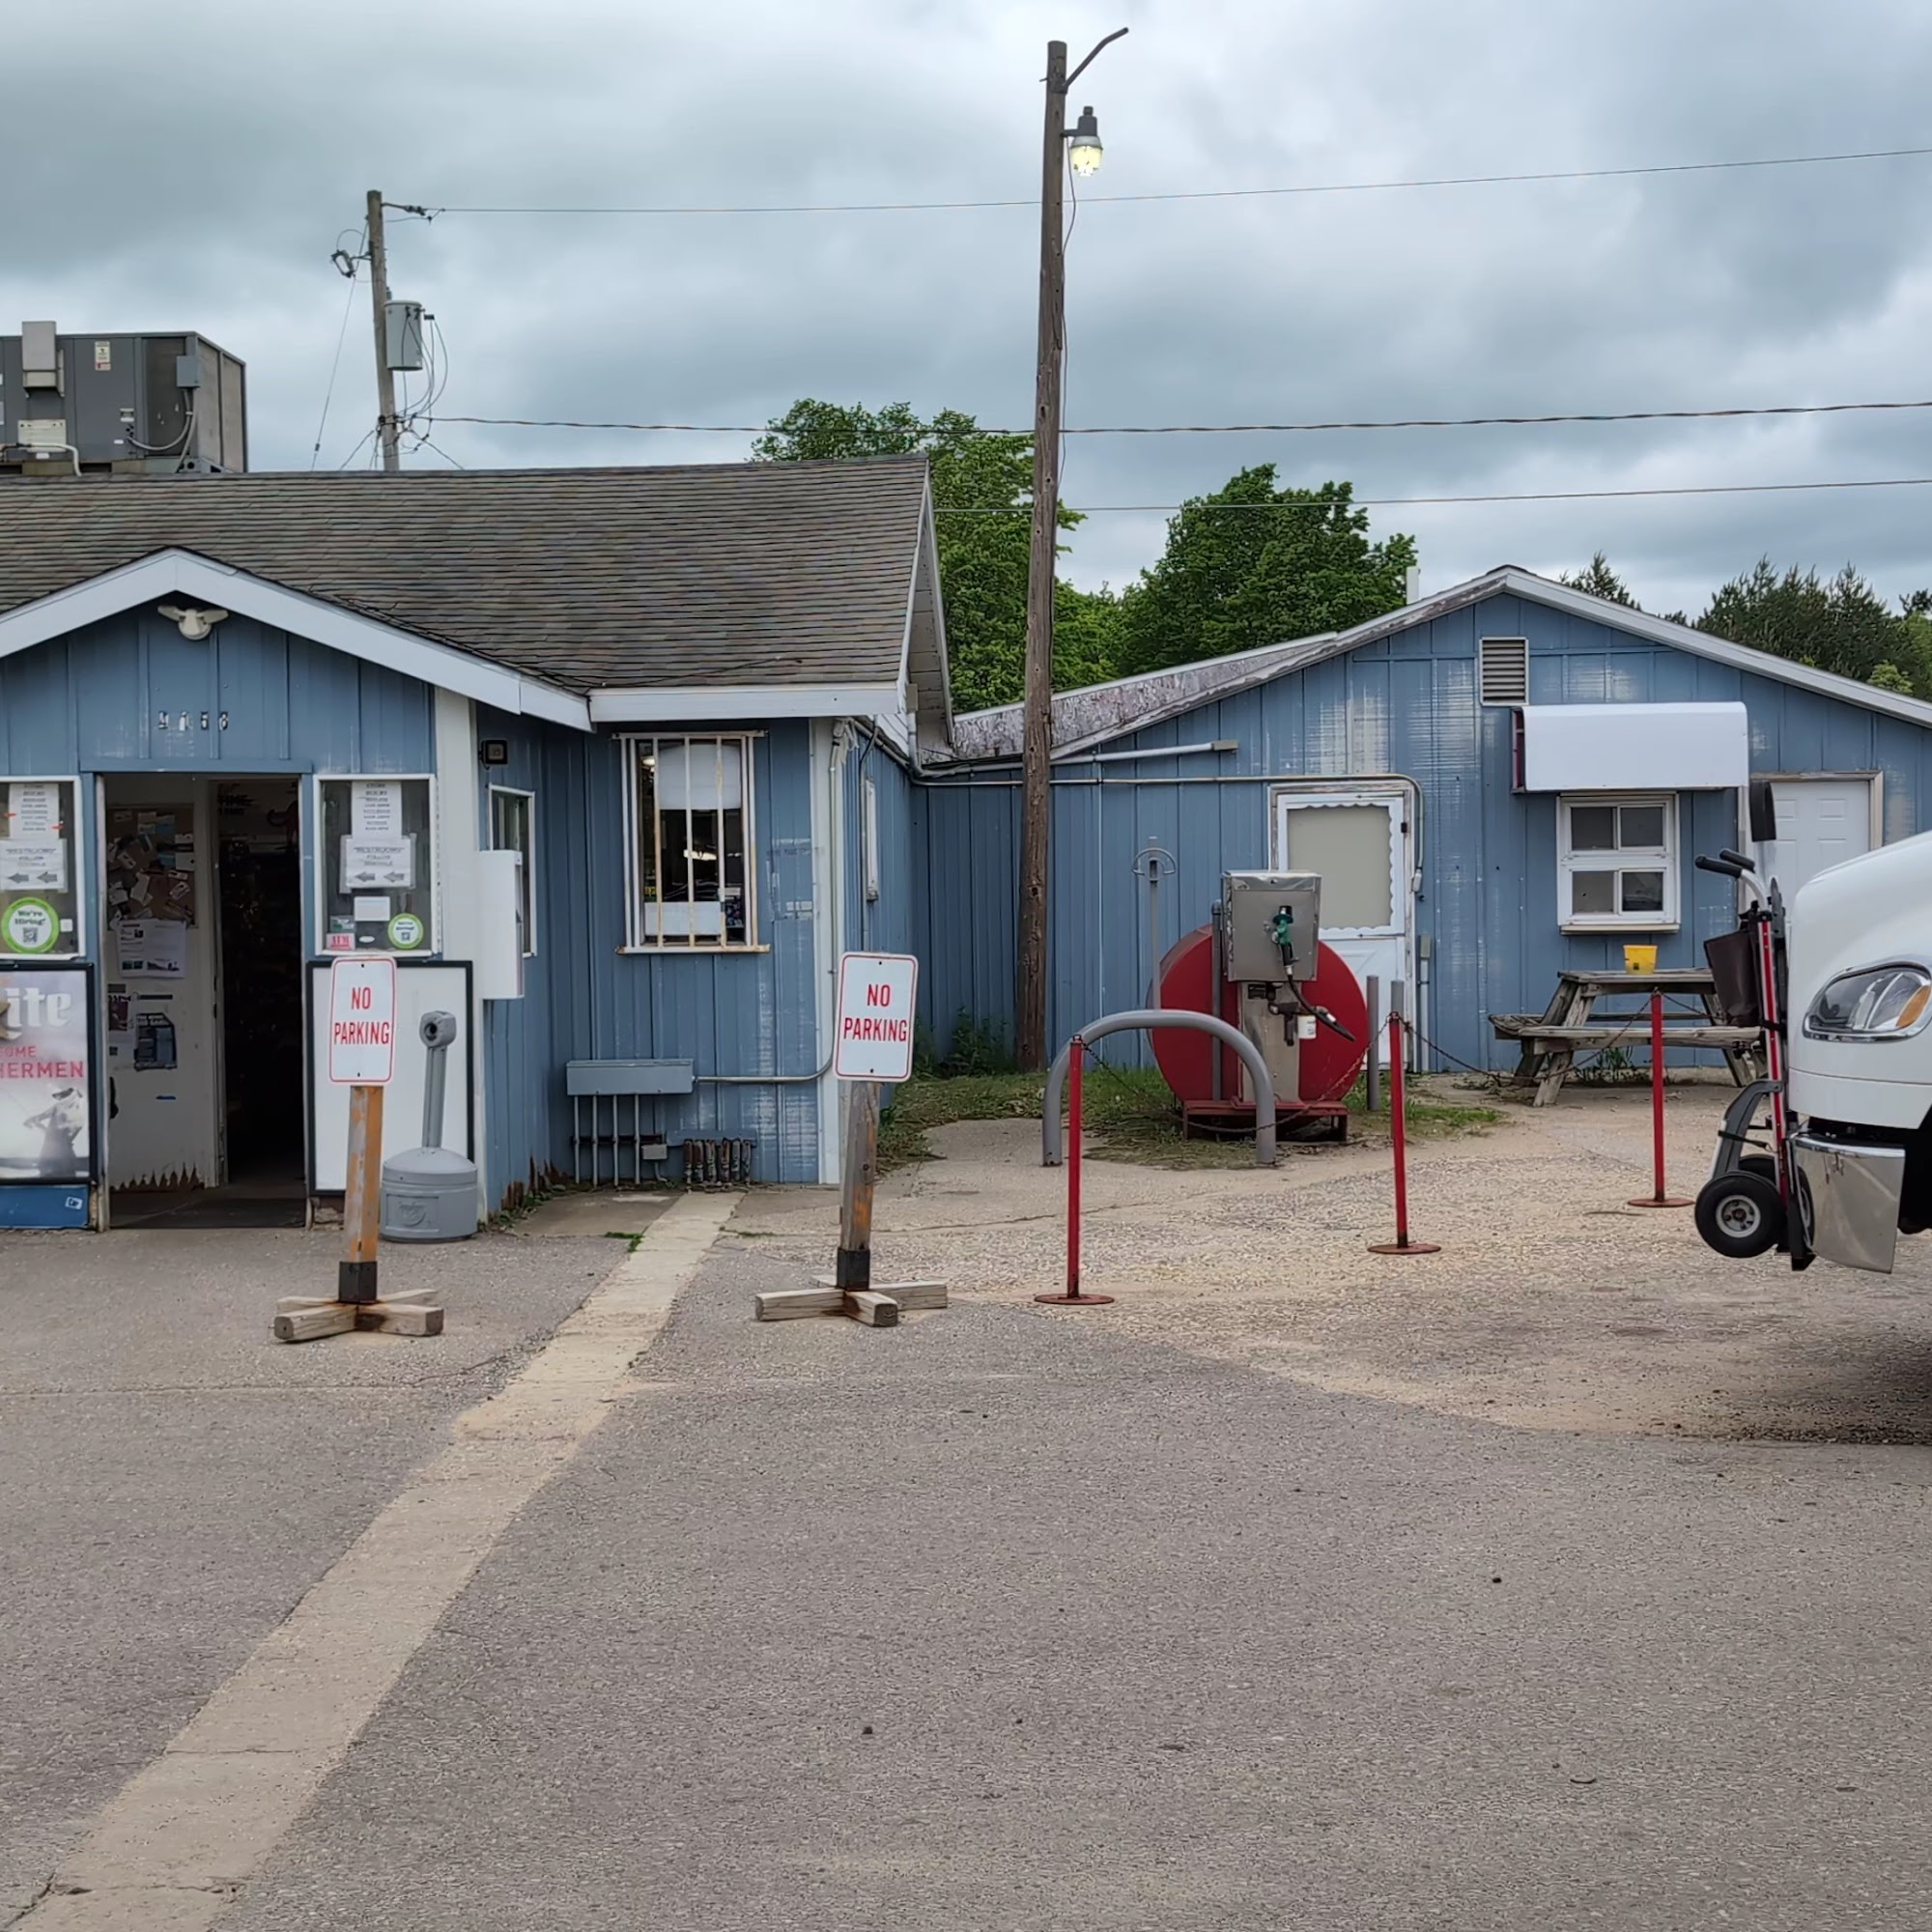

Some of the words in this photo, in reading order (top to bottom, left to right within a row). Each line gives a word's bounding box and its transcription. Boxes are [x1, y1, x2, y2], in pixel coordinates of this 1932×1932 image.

[351, 986, 371, 1009] NO
[867, 984, 891, 1007] NO
[0, 987, 71, 1039] ite
[334, 1022, 389, 1044] PARKING
[843, 1017, 907, 1041] PARKING
